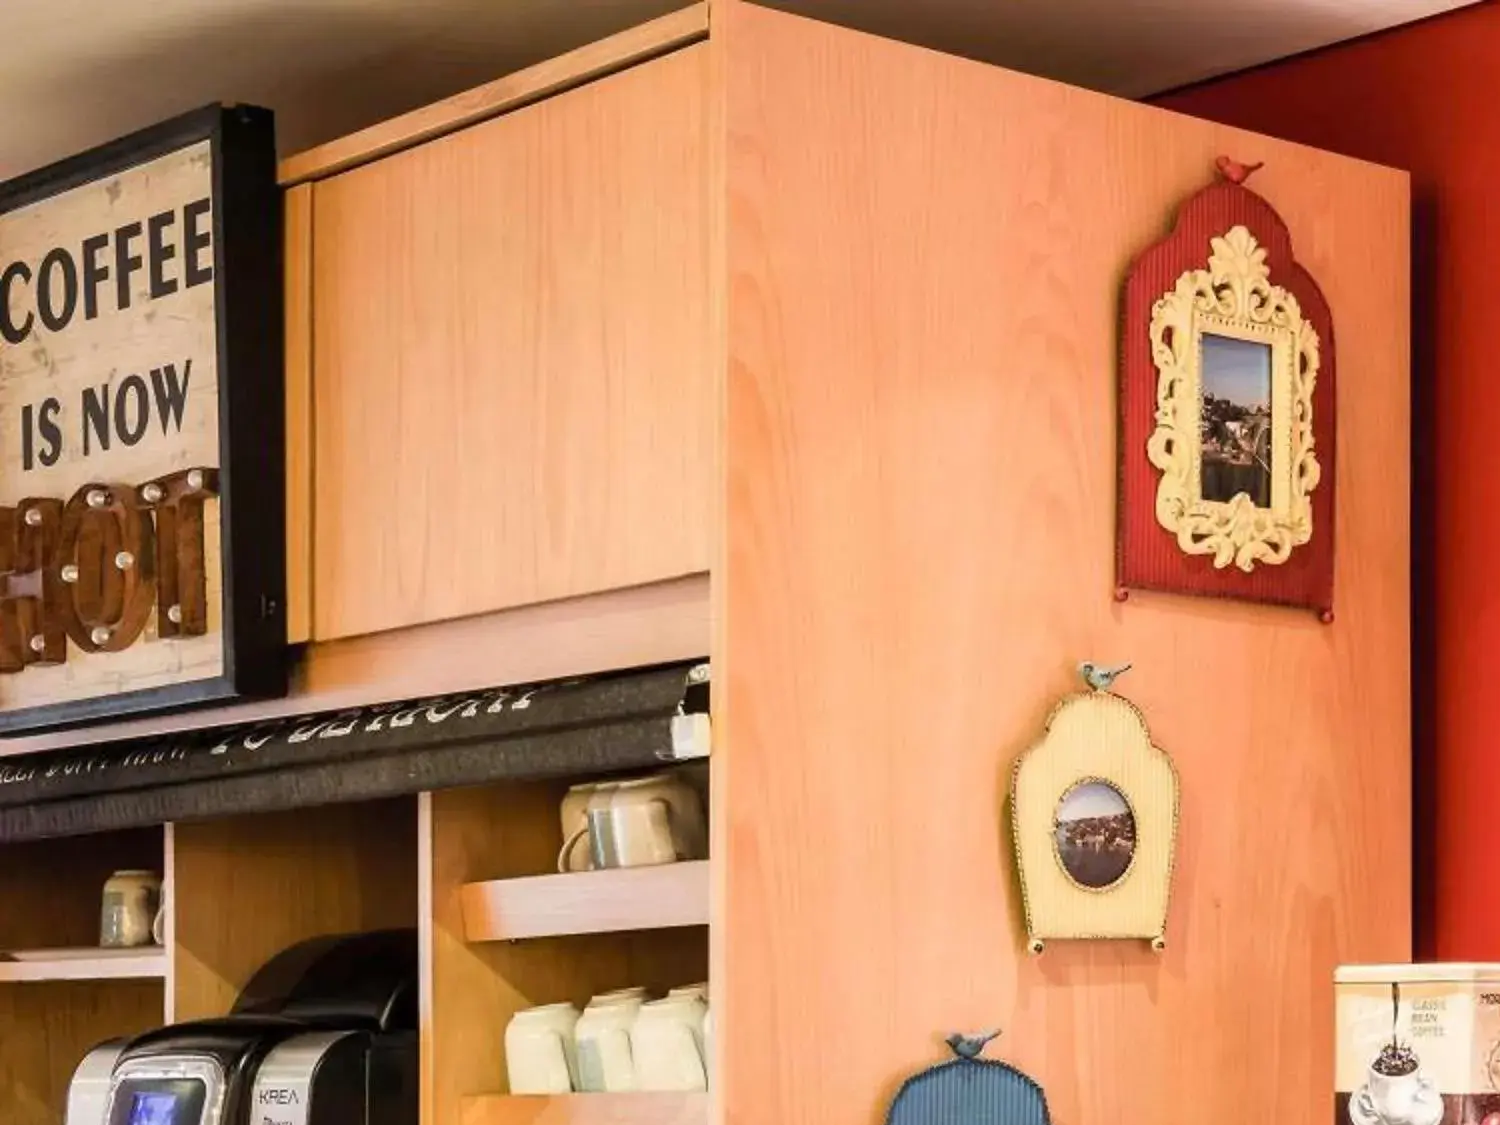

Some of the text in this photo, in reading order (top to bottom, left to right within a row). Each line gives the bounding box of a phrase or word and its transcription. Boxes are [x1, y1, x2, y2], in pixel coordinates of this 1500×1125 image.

[0, 198, 214, 344] COFFEE
[22, 359, 192, 470] IS NOW
